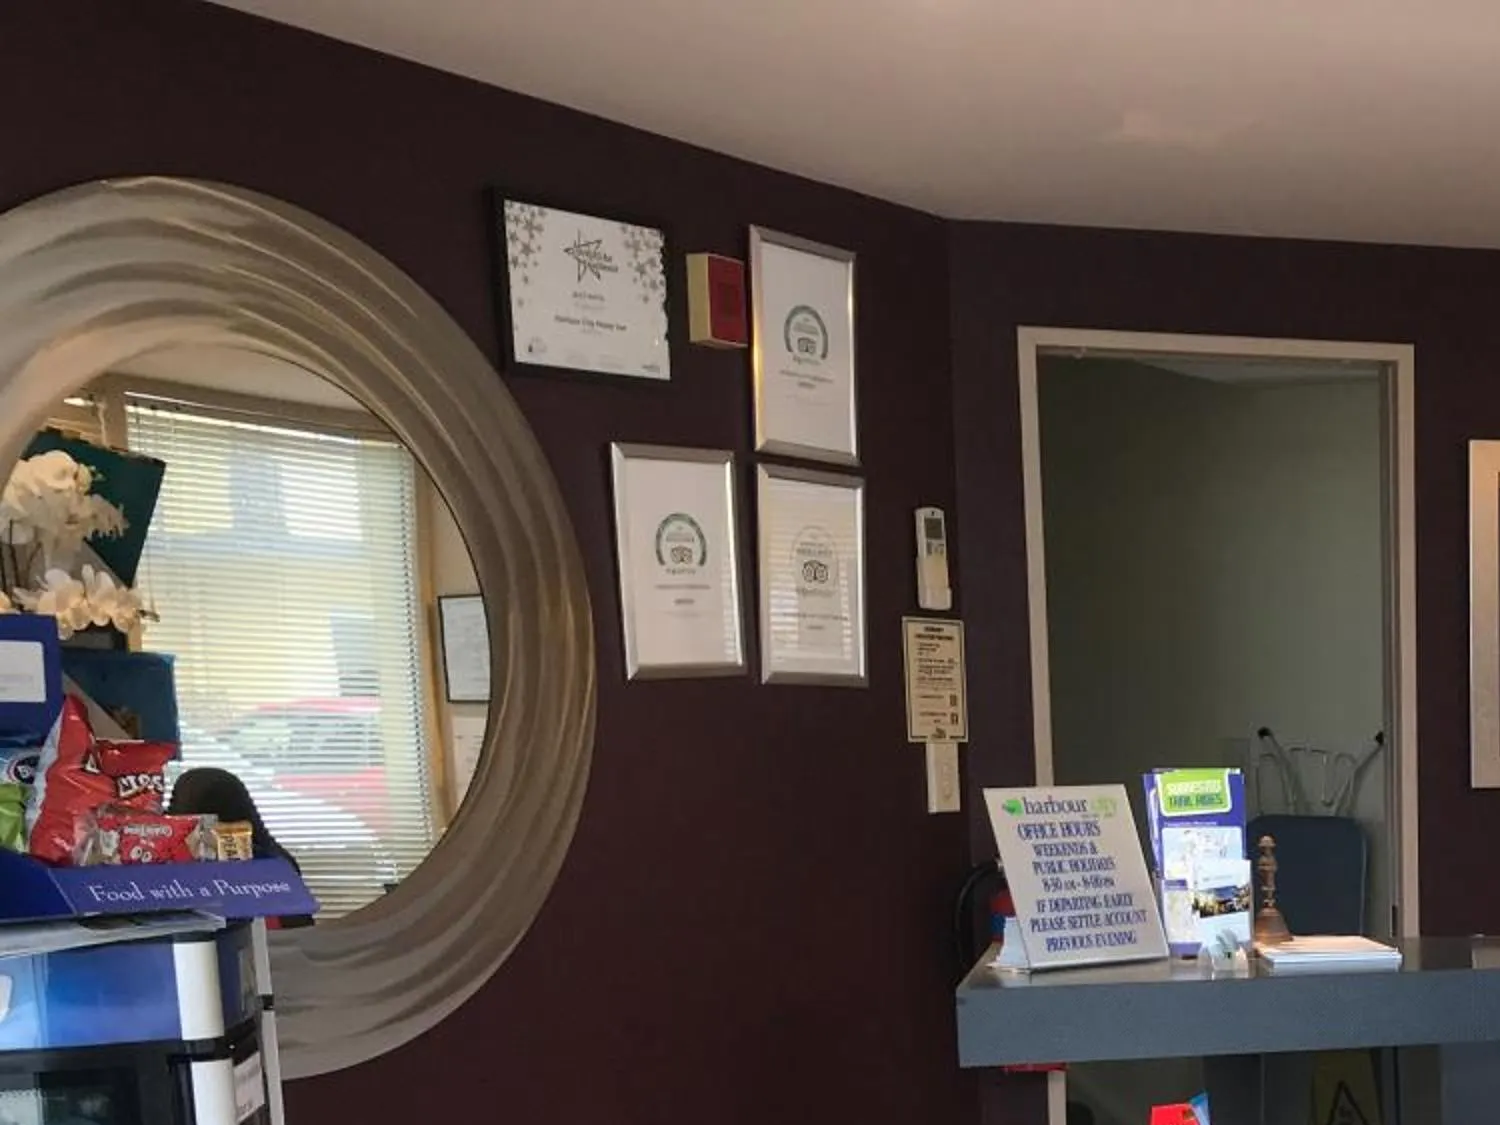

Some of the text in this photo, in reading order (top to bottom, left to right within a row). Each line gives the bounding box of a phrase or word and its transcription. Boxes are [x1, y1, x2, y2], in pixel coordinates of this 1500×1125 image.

[1022, 795, 1088, 815] harbour
[1017, 820, 1101, 841] OFFICE HOURS
[1032, 842, 1087, 857] WEEKENDS
[1032, 856, 1116, 876] PUBLIC HOLIDAYS
[88, 879, 291, 903] Food with a Purpose
[1049, 896, 1102, 912] DEPARTING
[1103, 893, 1134, 909] EARLY
[1030, 909, 1147, 933] PLEASE SETTLE ACCOUNT
[1045, 931, 1138, 953] PREVIOUS EVENING
